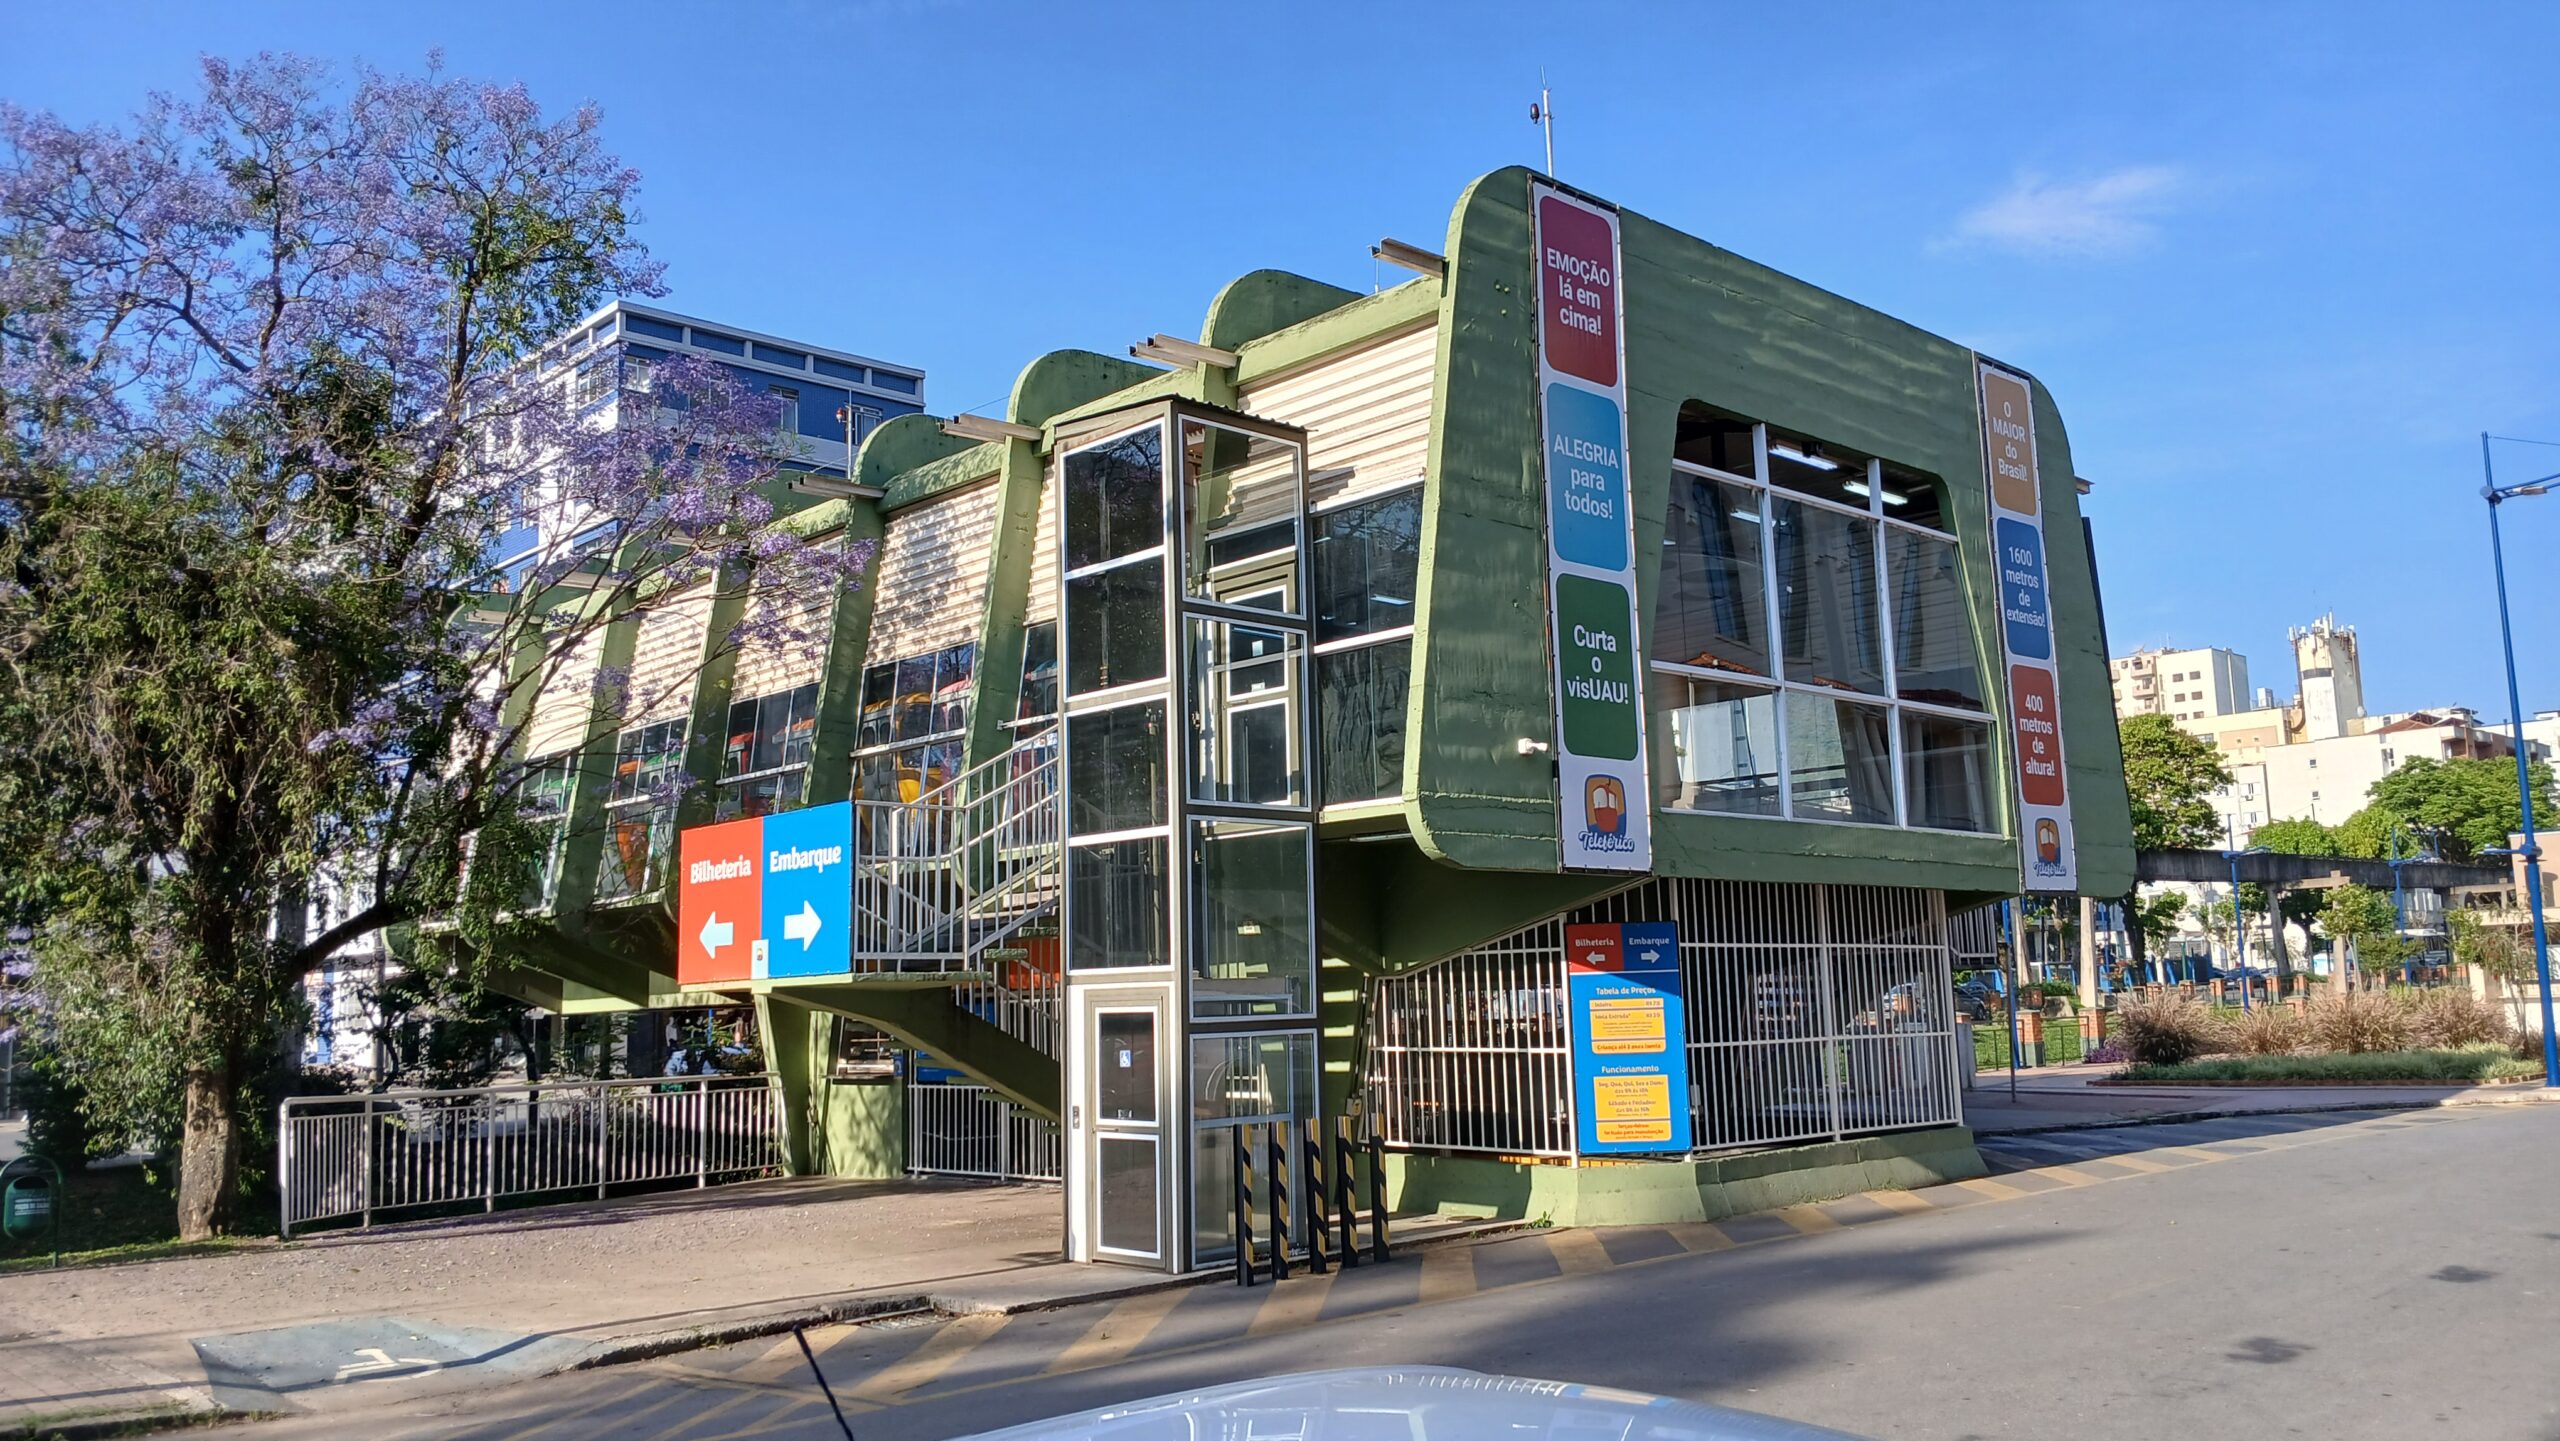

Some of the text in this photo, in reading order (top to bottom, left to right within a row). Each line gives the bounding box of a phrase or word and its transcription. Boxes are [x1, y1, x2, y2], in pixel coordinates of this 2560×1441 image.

[1546, 247, 1611, 287] EMOÇÃO
[1559, 275, 1601, 310] lá em
[1559, 306, 1603, 337] cima!
[1993, 416, 2026, 444] MAIOR
[1553, 433, 1620, 470] ALEGRIA
[2005, 441, 2018, 460] do
[1570, 467, 1605, 493] para
[1998, 457, 2028, 482] Brasil!
[1564, 488, 1613, 520] todos!
[2008, 546, 2033, 568] 1600
[2005, 568, 2039, 589] metros
[2018, 589, 2031, 608] de
[2006, 607, 2046, 628] extensão!
[1573, 624, 1617, 653] Curta
[1591, 656, 1602, 674] o
[1566, 679, 1629, 705] visUAU!
[2024, 693, 2044, 714] 400
[2019, 716, 2053, 736] metros
[2032, 736, 2045, 755] de
[2025, 759, 2056, 777] altura!
[1578, 831, 1635, 852] Teleférico
[690, 854, 752, 884] Bilheteria
[769, 845, 842, 874] Embarque
[1575, 937, 1615, 947] Bilheteria
[1628, 937, 1670, 947] Embarque
[1596, 986, 1656, 996] Tabela de Preços
[1601, 1065, 1660, 1074] Funcionamento
